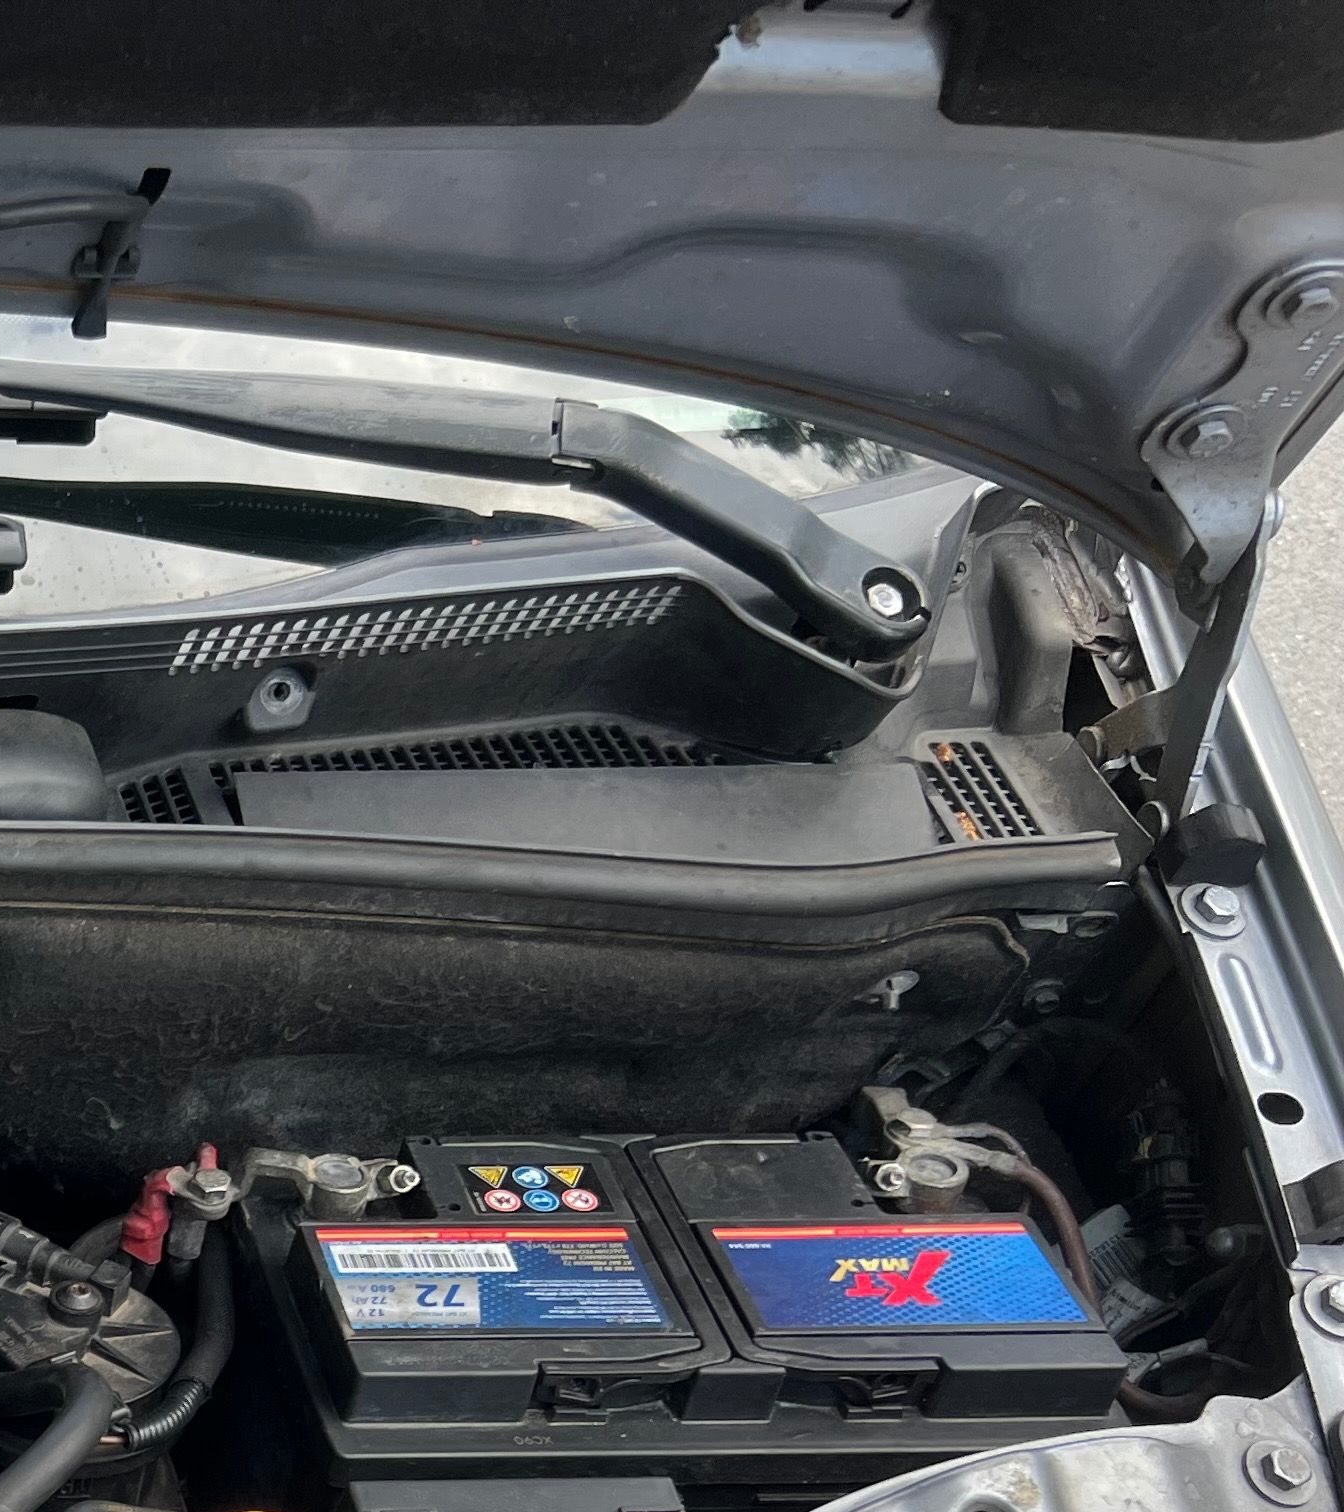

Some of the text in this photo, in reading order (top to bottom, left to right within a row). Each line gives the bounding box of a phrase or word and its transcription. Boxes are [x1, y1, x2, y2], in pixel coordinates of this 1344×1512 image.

[829, 1257, 910, 1283] MAX
[370, 1284, 396, 1293] 680
[415, 1283, 465, 1307] 72
[371, 1296, 387, 1305] 72
[356, 1308, 385, 1317] 12 V
